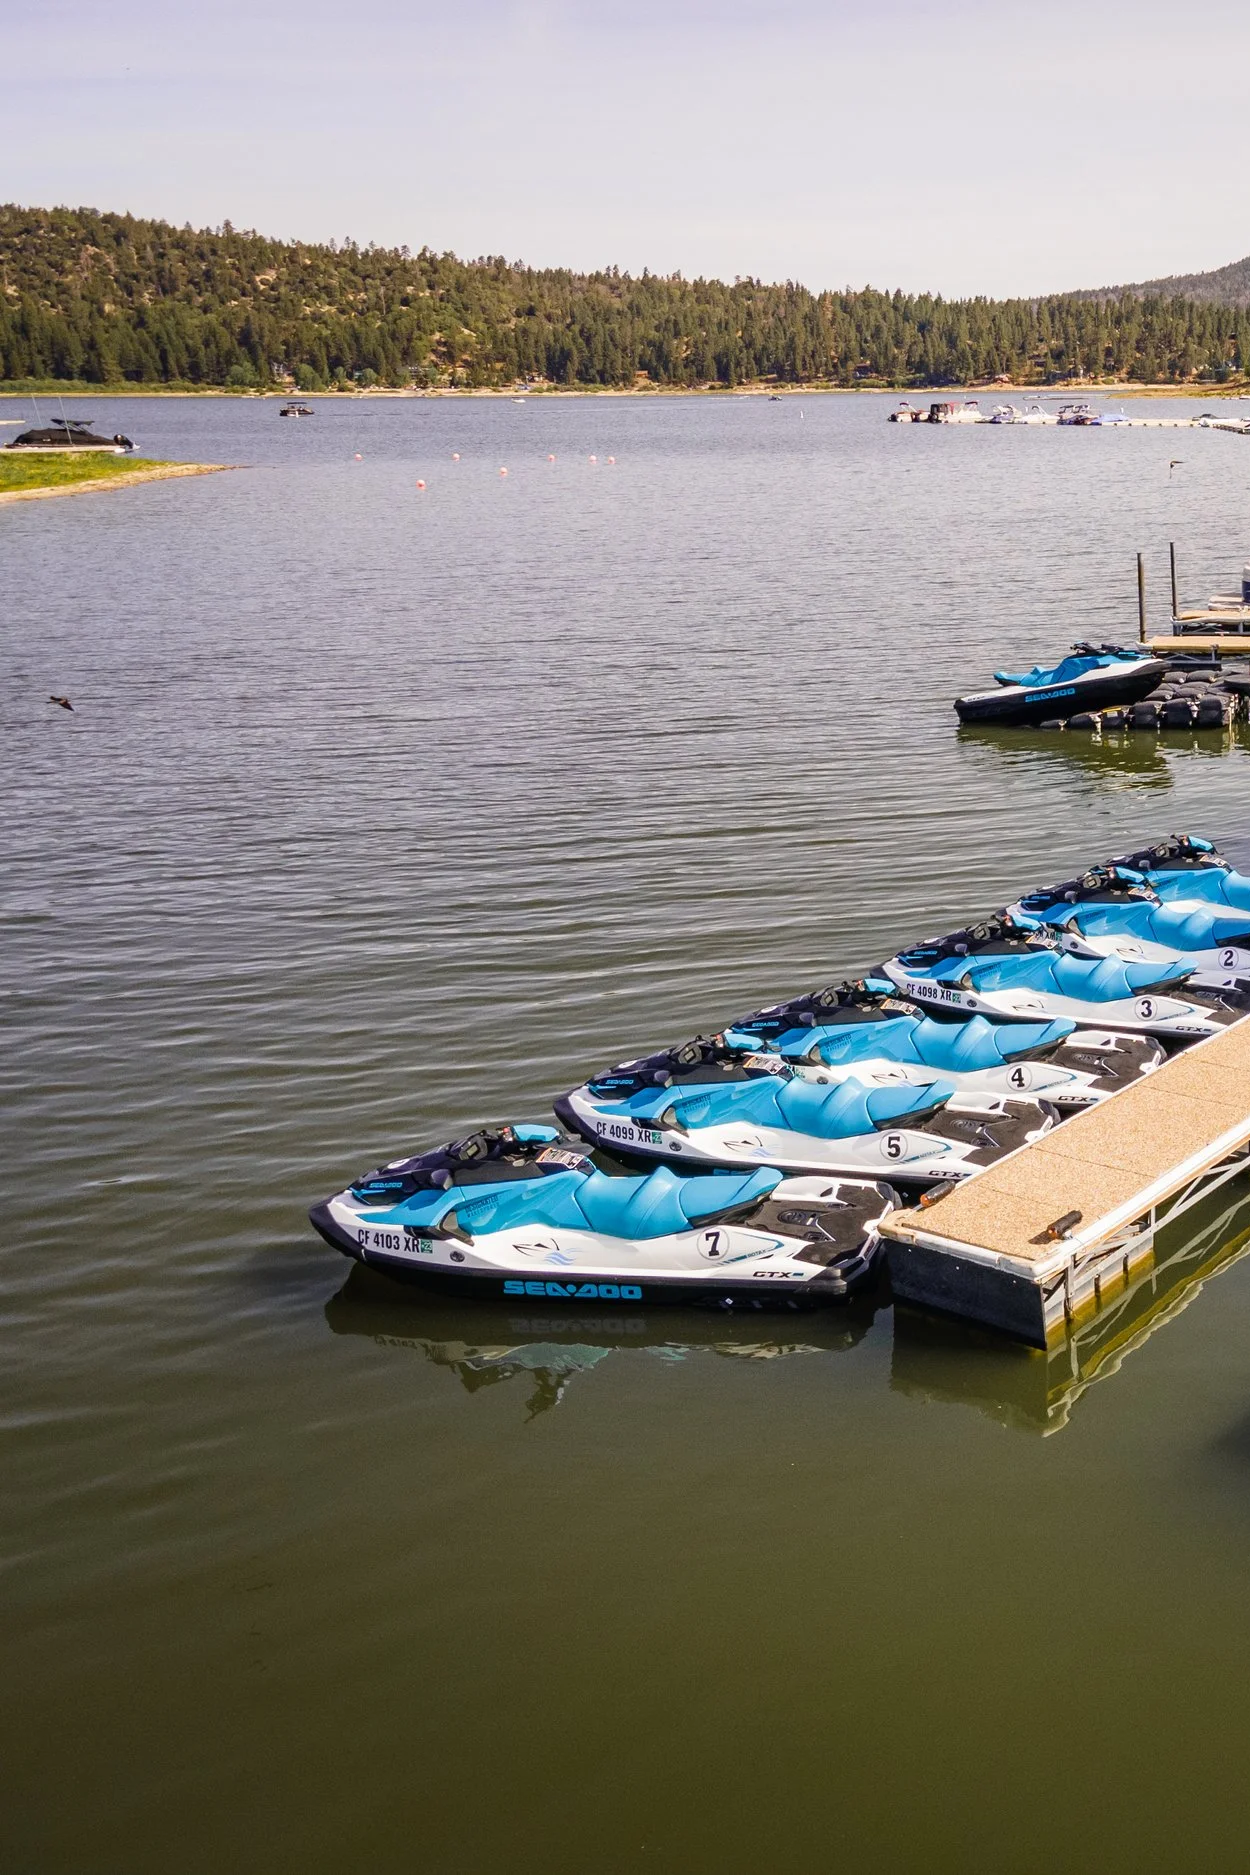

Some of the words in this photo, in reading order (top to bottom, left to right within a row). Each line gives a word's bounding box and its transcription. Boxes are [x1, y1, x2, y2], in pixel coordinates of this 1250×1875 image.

[1223, 949, 1234, 967] 2
[906, 982, 916, 995] CF
[917, 984, 938, 999] 4098
[940, 989, 952, 1002] XR
[1141, 999, 1153, 1018] 3
[1011, 1067, 1026, 1088] 4
[596, 1121, 608, 1135] CF
[609, 1124, 634, 1140] 4099
[637, 1128, 652, 1143] XR
[887, 1135, 902, 1159] 5
[357, 1229, 371, 1245] CF
[373, 1232, 400, 1251] 4103
[404, 1236, 420, 1254] XR
[704, 1231, 721, 1258] 7
[752, 1271, 792, 1279] GTX
